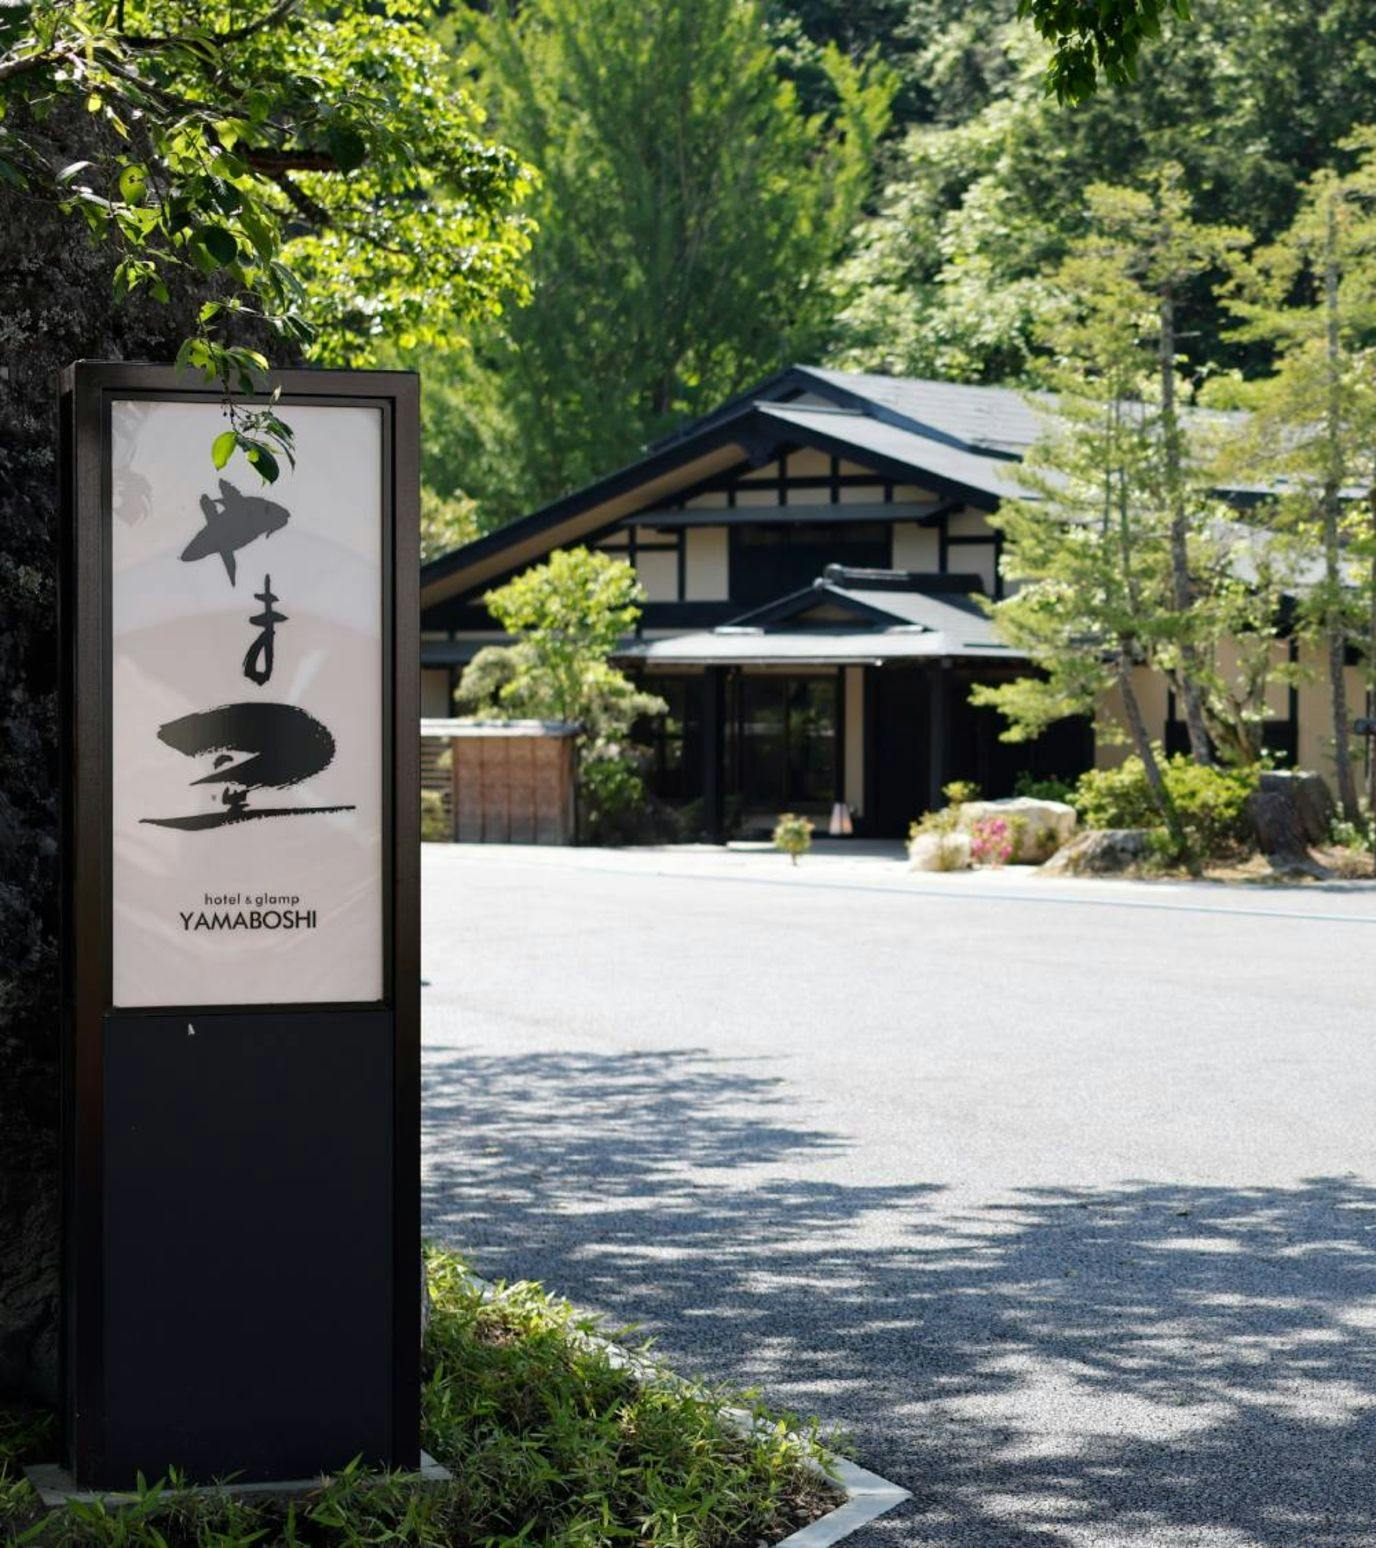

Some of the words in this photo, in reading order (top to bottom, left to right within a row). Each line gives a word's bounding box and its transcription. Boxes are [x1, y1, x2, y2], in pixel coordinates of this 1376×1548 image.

[204, 893, 241, 905] hotel
[244, 895, 252, 905] &
[255, 893, 300, 907] glamp
[179, 910, 317, 931] YAMABOSHI
